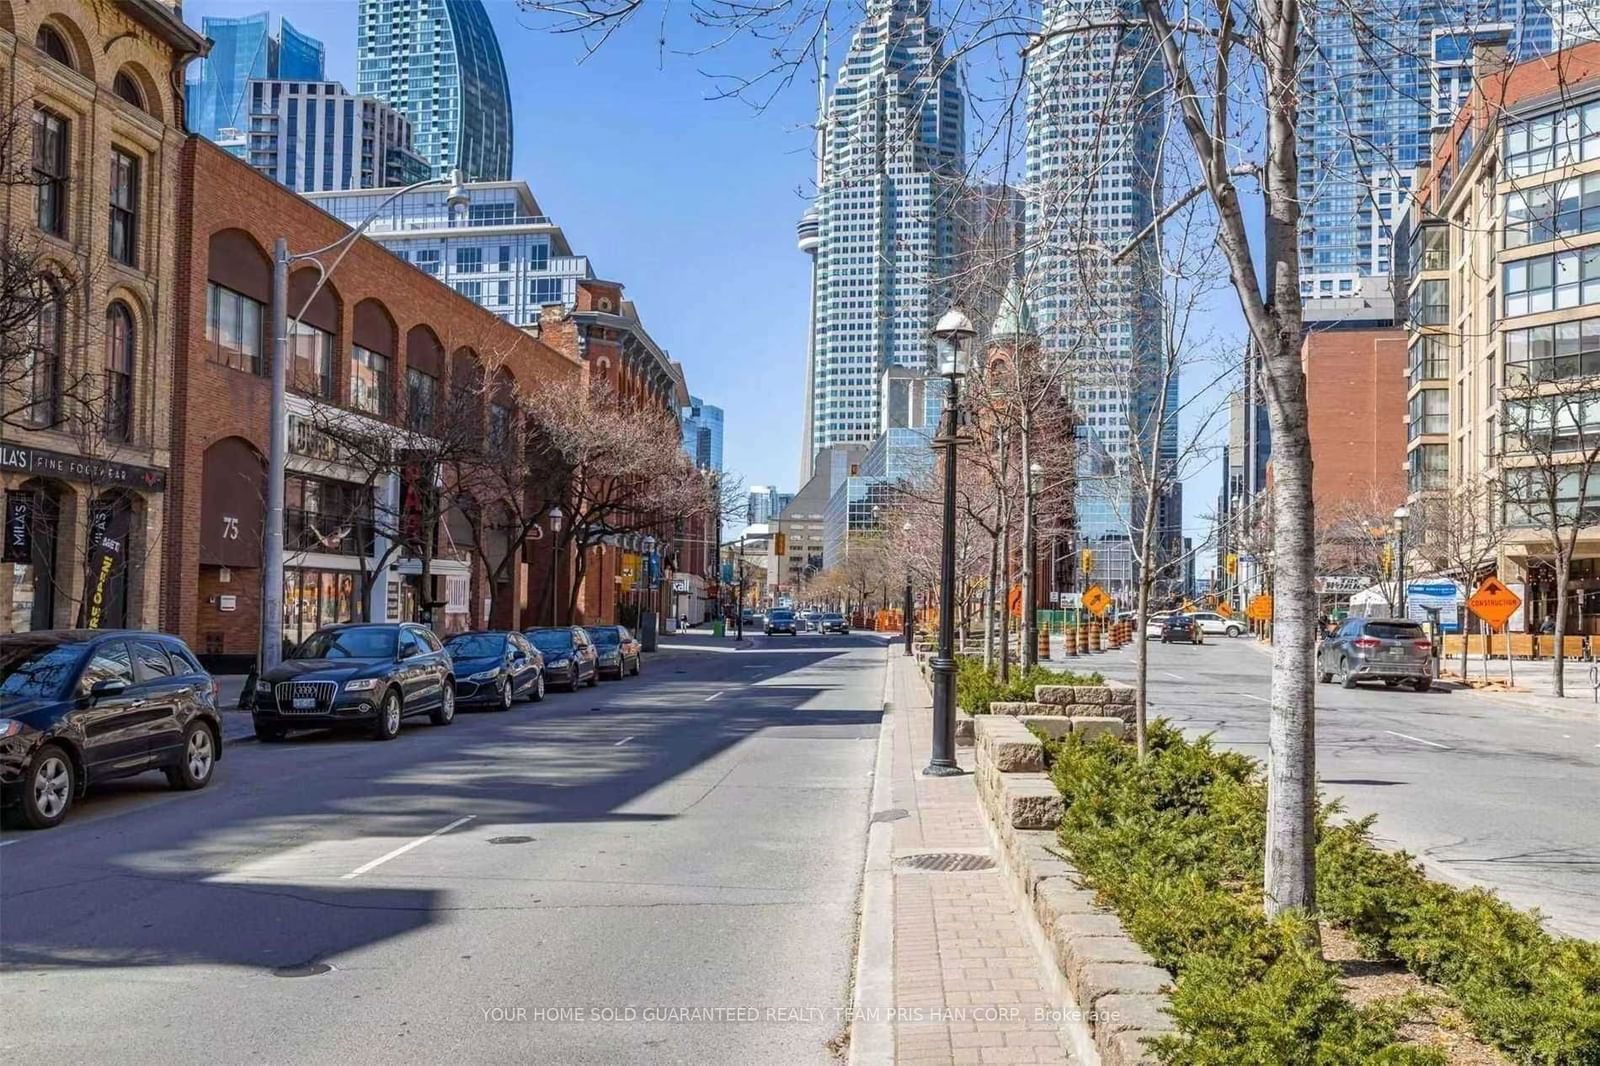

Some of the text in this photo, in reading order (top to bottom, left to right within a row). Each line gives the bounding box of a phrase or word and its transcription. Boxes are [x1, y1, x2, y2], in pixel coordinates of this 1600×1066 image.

[0, 447, 26, 468] ILA'S
[37, 456, 63, 472] FINE
[13, 504, 26, 545] MILA'S
[223, 516, 239, 540] 75
[93, 555, 113, 604] OPEN!
[1471, 599, 1517, 607] CONSTRUCTION
